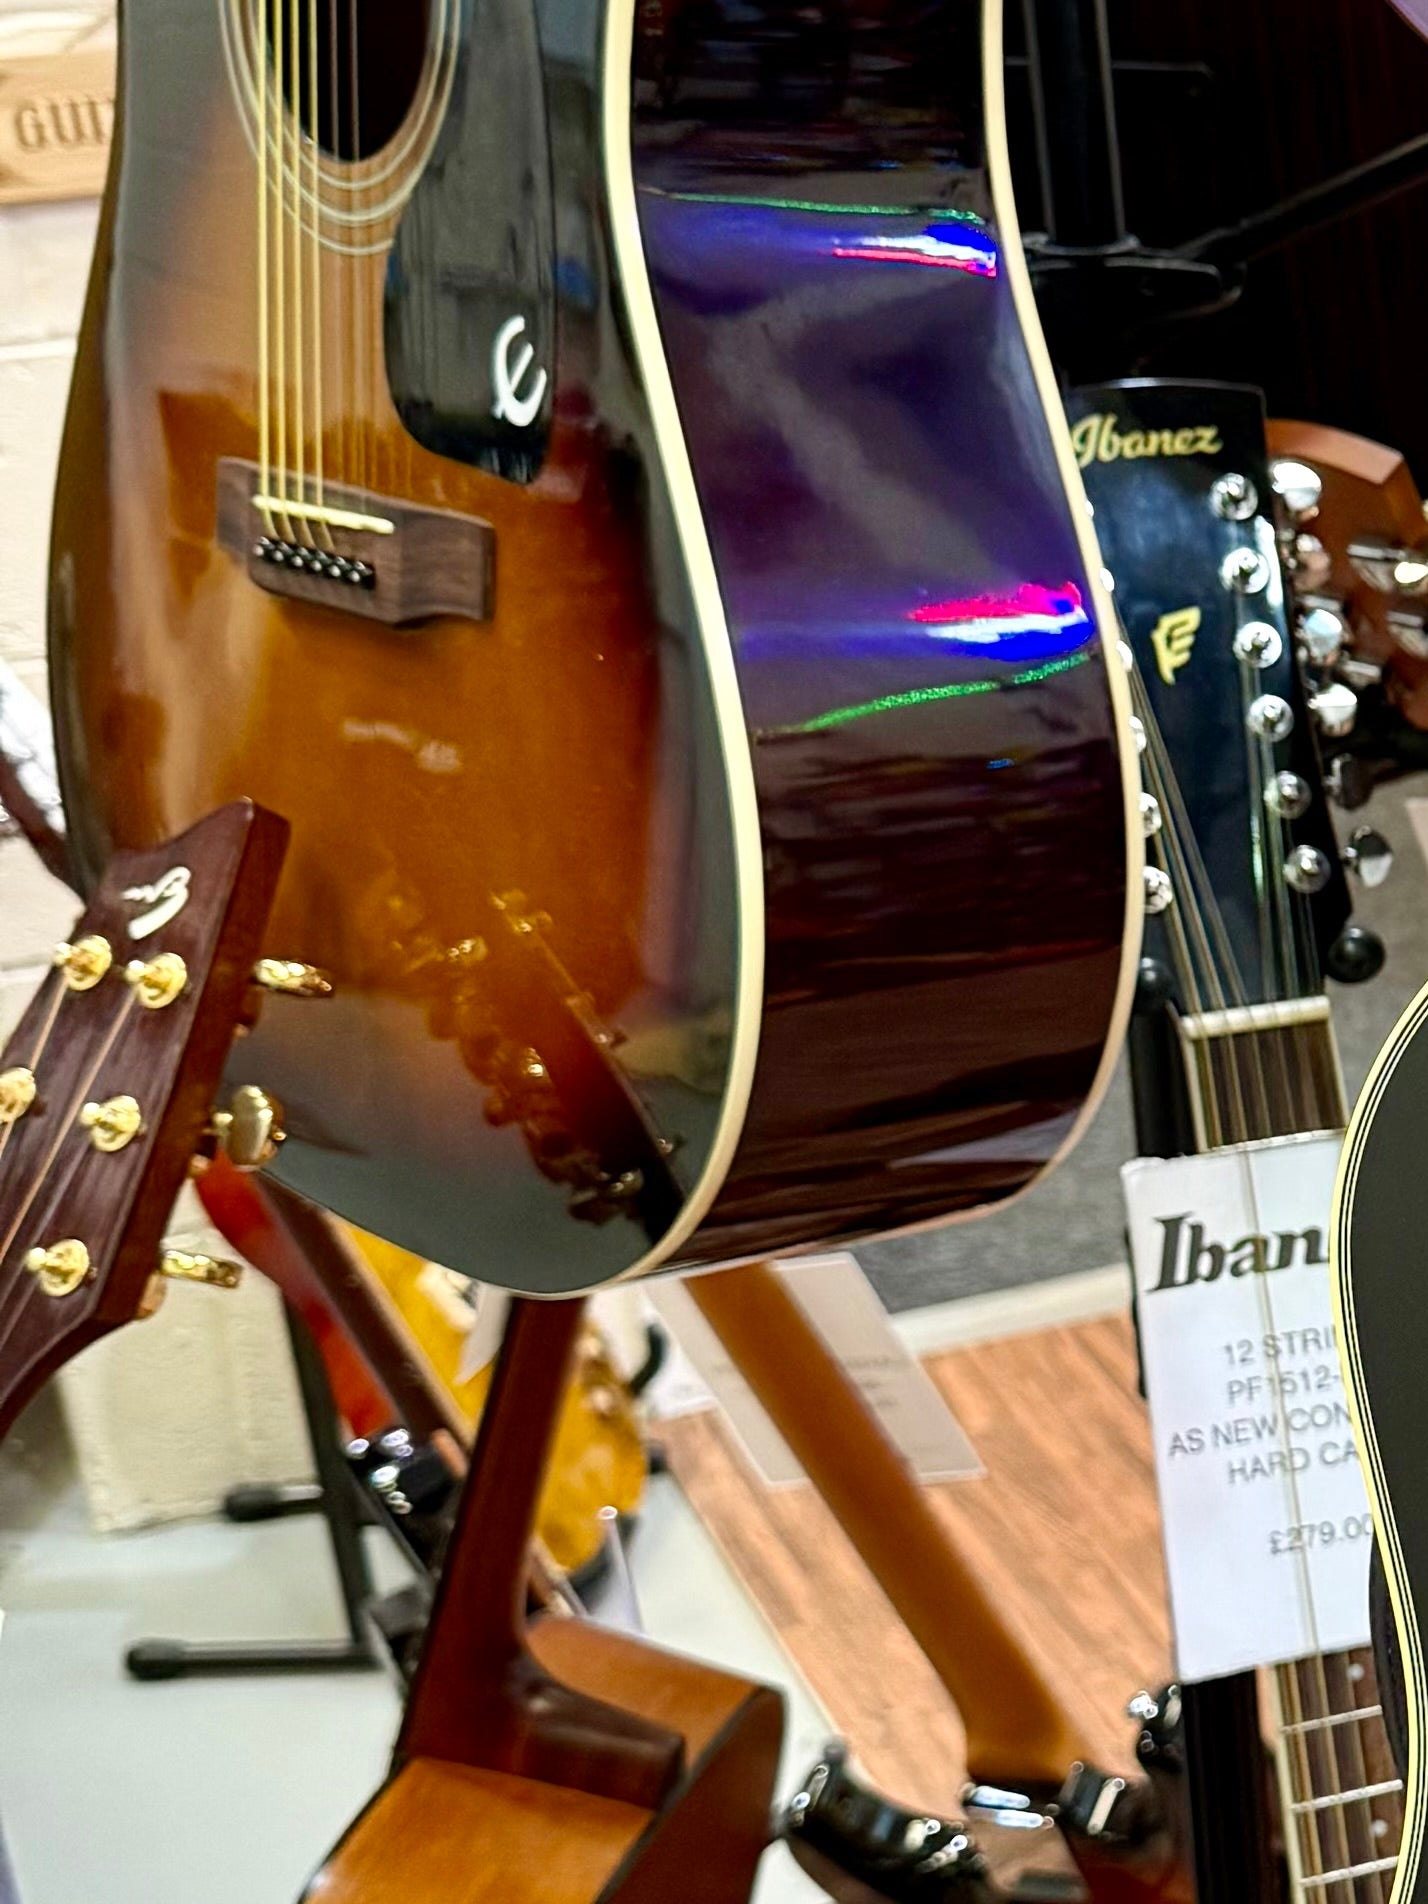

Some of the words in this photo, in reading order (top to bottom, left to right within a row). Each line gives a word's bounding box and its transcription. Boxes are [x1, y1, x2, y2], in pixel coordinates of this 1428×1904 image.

[1072, 410, 1225, 469] Ibanez
[1223, 1339, 1254, 1365] 12
[1262, 1324, 1338, 1358] STRI
[1168, 1427, 1206, 1458] AS
[1210, 1413, 1279, 1448] NEW
[1227, 1446, 1311, 1485] HARD
